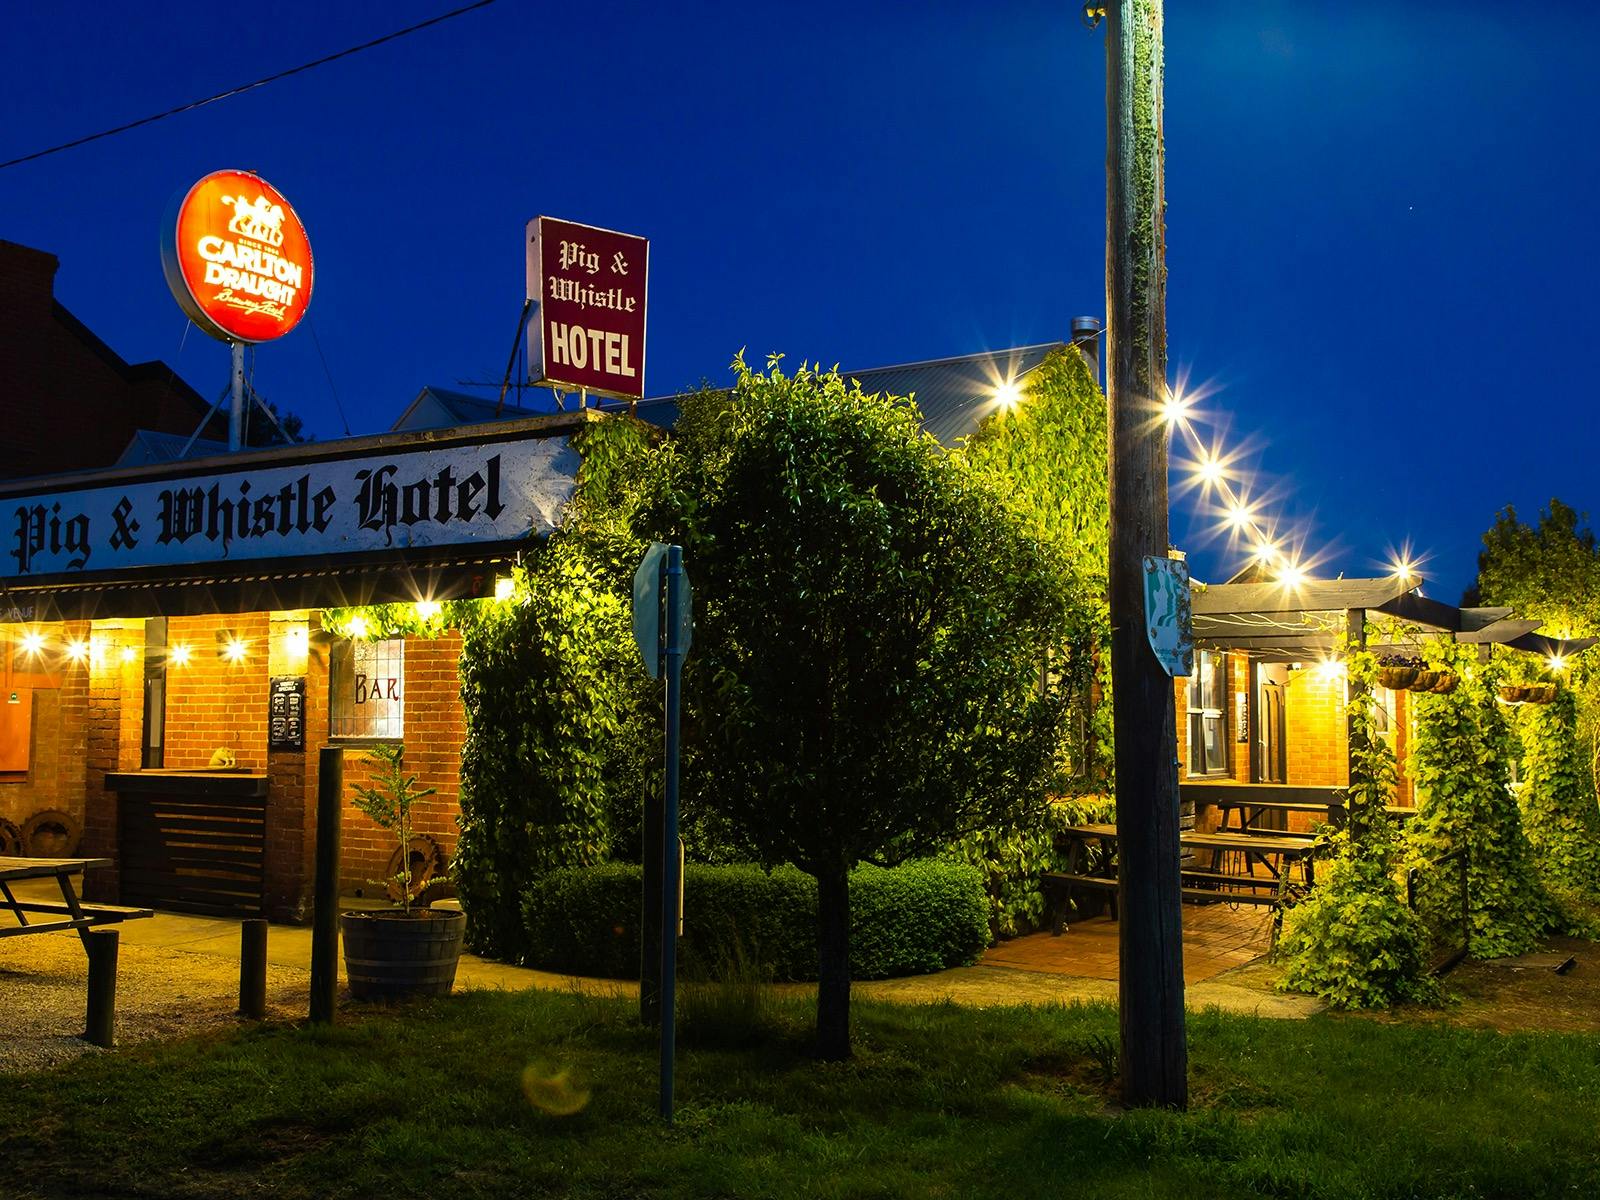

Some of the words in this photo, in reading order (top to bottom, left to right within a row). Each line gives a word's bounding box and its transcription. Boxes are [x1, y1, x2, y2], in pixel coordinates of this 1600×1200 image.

[197, 235, 302, 289] CARLTON
[558, 240, 600, 275] Pig
[610, 251, 629, 276] &
[204, 261, 296, 306] DRAUGHT
[549, 276, 636, 313] Whistle
[550, 320, 636, 378] HOTEL
[10, 501, 92, 575] Pig
[109, 495, 141, 551] &
[156, 473, 337, 559] Whistle
[353, 453, 506, 548] Hotel
[355, 674, 400, 705] BAR
